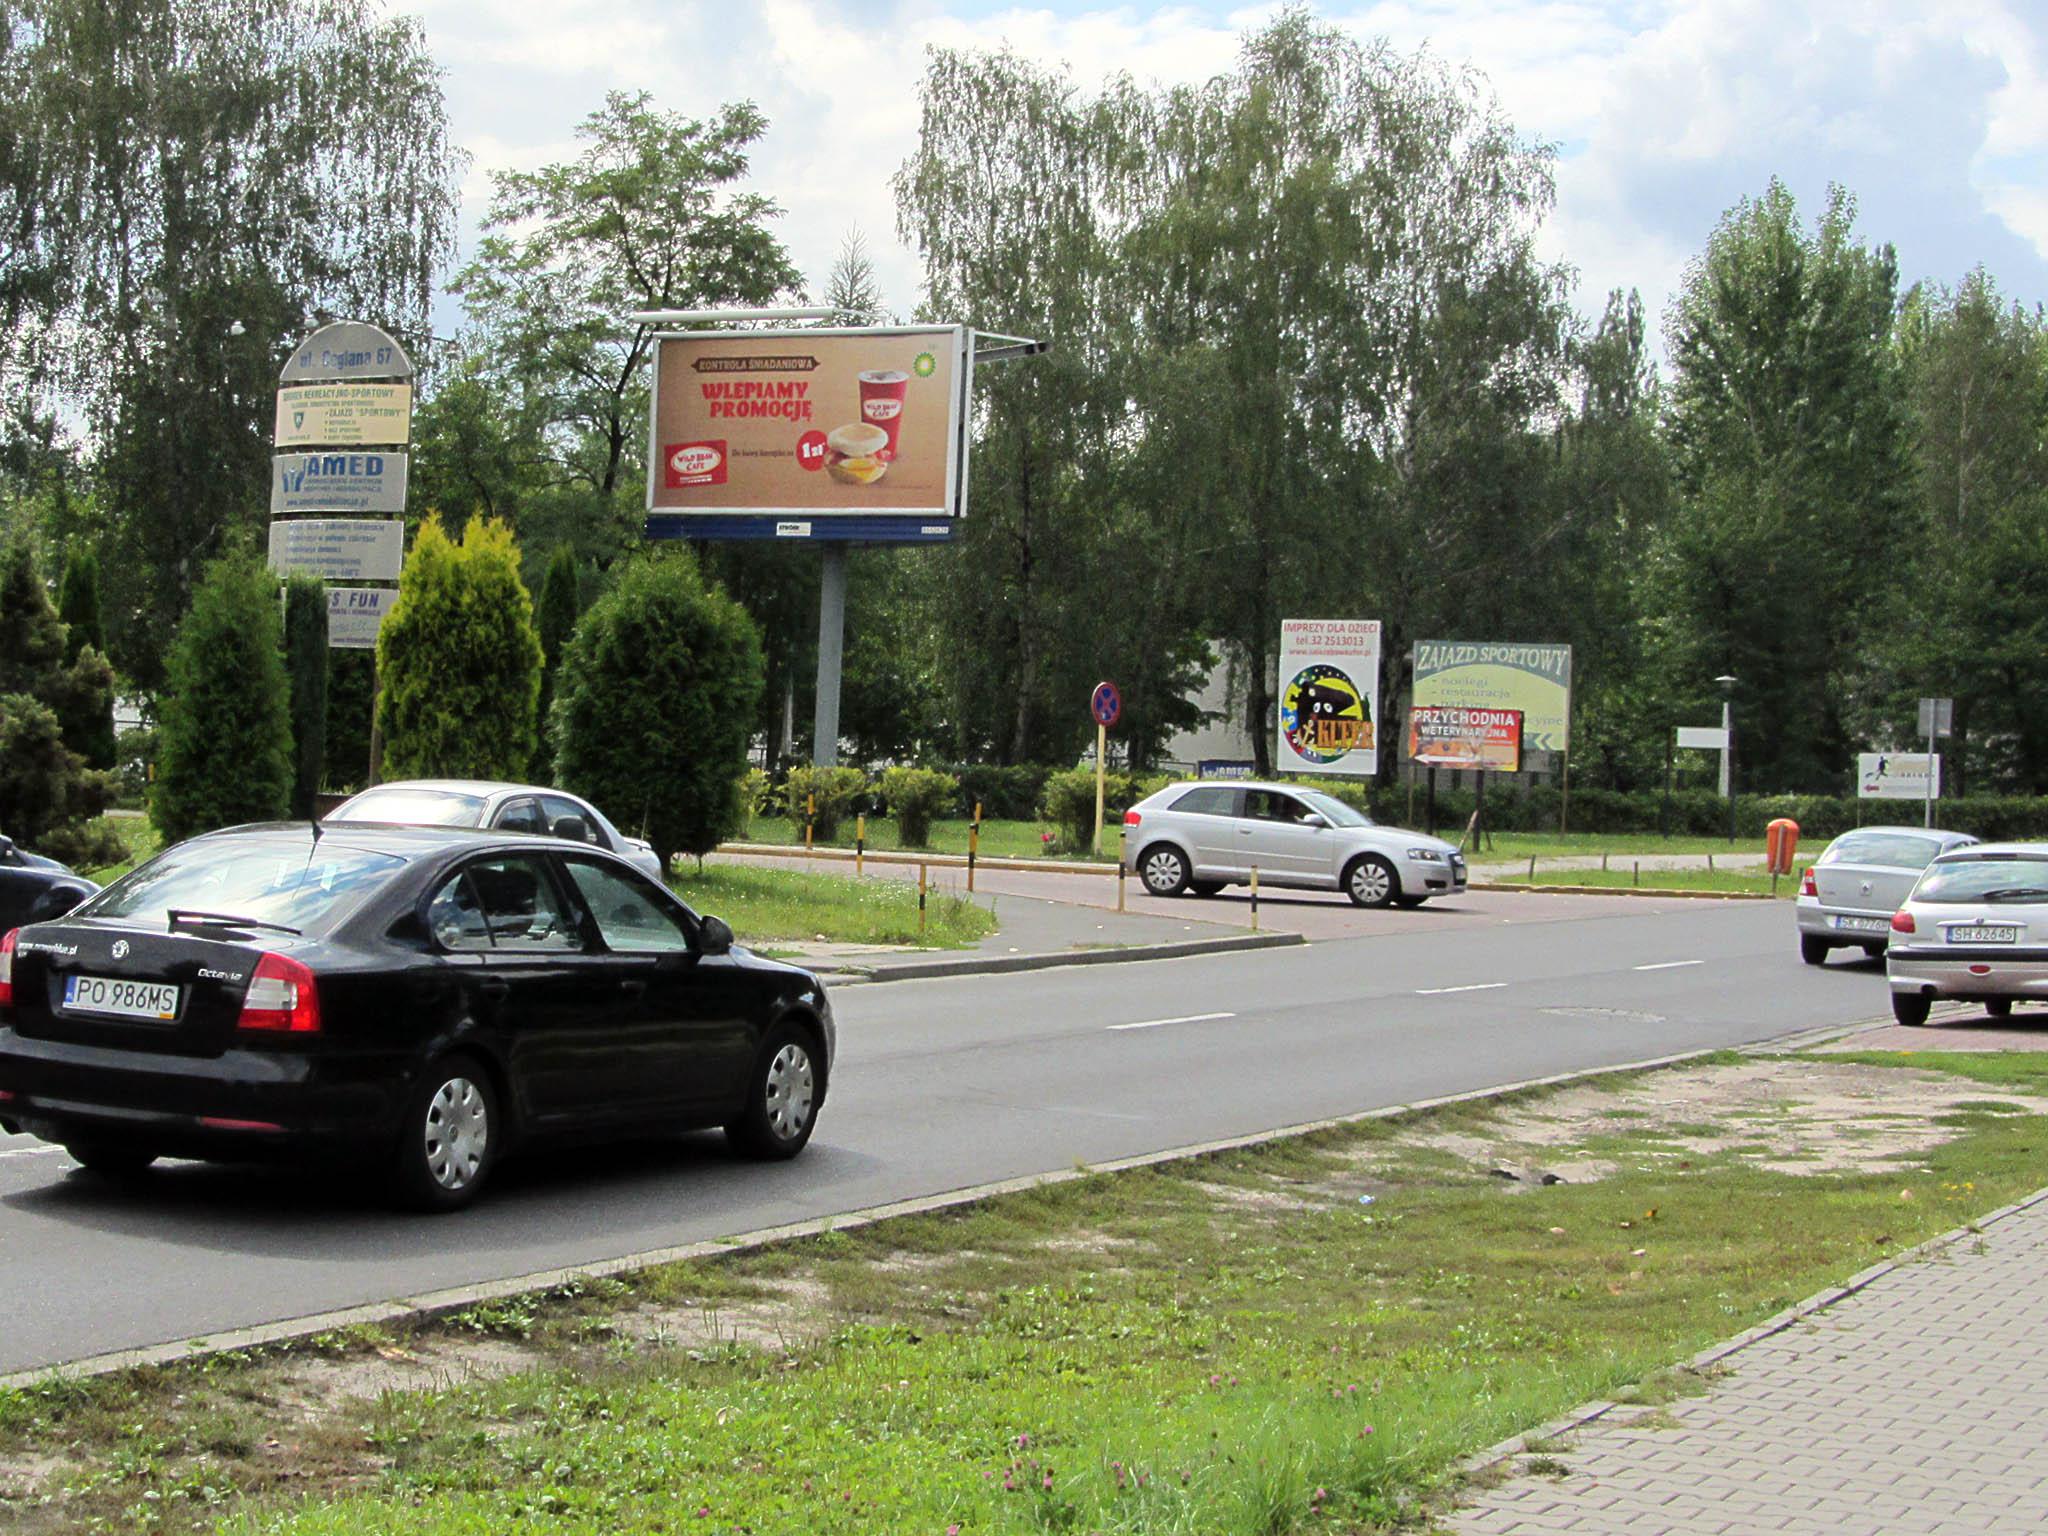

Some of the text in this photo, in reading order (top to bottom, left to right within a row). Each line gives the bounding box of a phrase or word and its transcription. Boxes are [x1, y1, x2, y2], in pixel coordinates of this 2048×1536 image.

[376, 347, 392, 364] 67
[702, 382, 809, 400] WLEPIAMY
[710, 400, 813, 422] PROMOCJĘ
[349, 592, 379, 608] FUN
[1284, 624, 1377, 633] IMPREZY DLA DZIECI
[1312, 635, 1322, 645] 32
[1325, 637, 1364, 646] 2513013
[1418, 646, 1567, 676] ZAJAZD SPORTOWY
[1414, 710, 1515, 726] PRZYCHODNIA
[1421, 726, 1508, 738] WETERYNARYJNA
[1955, 928, 2012, 940] SH 62645
[198, 968, 242, 981] Octavia
[77, 979, 175, 1012] PO 986MS
